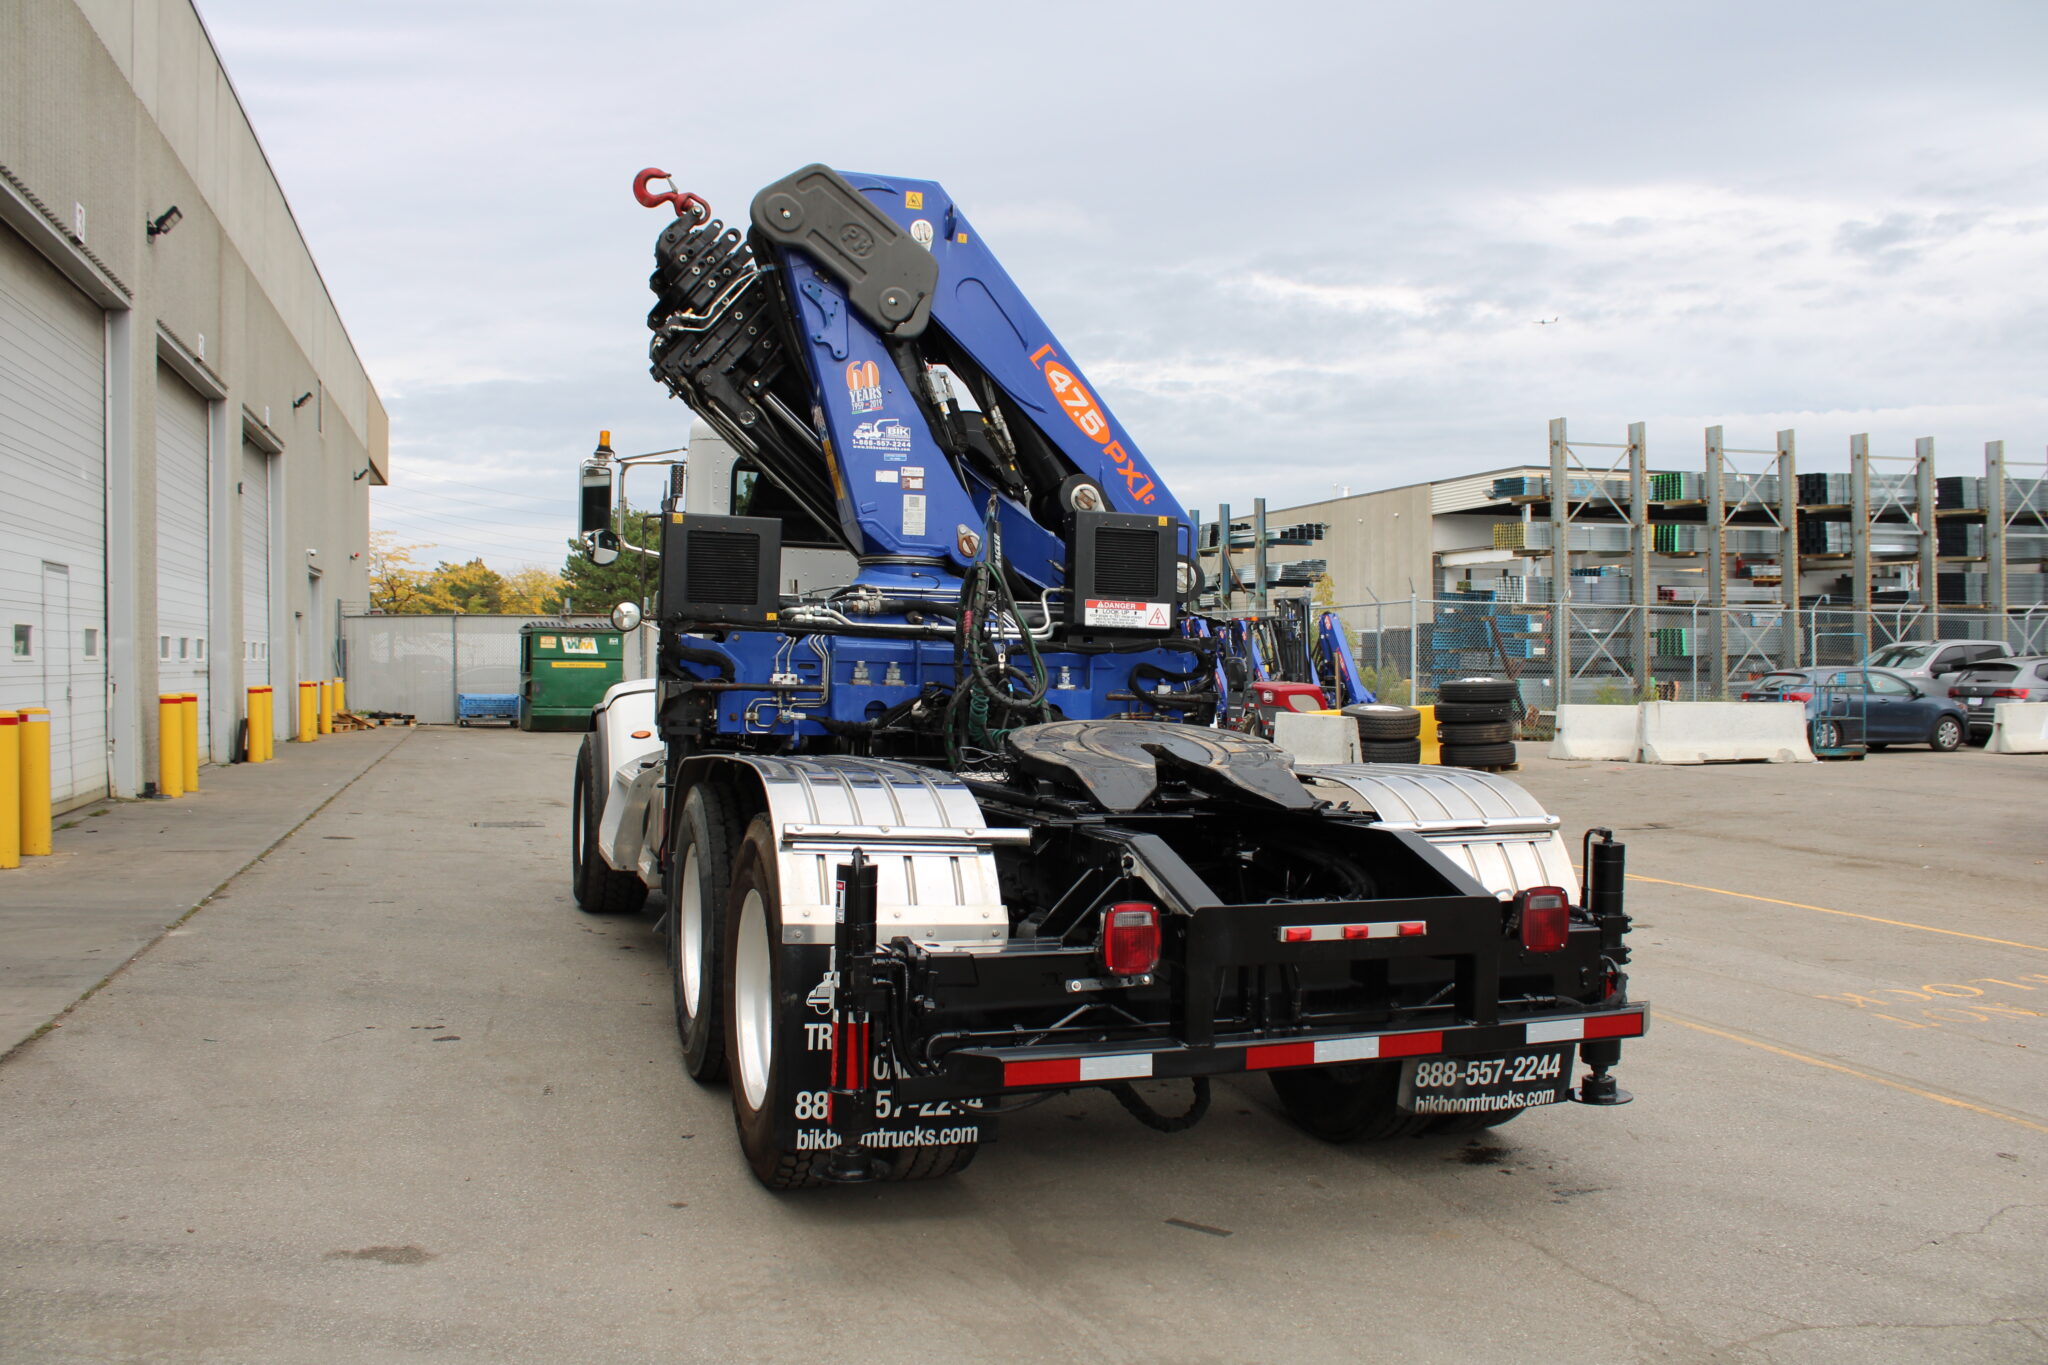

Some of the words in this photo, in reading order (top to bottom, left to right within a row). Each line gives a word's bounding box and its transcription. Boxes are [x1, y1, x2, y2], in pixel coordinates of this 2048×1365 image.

[846, 360, 879, 390] 60
[850, 385, 882, 402] YEARS
[1415, 1053, 1561, 1088] 888-557-2244
[1415, 1088, 1555, 1114] bikboomtrucks.com
[796, 1125, 979, 1150] bikbmtrucks.com
